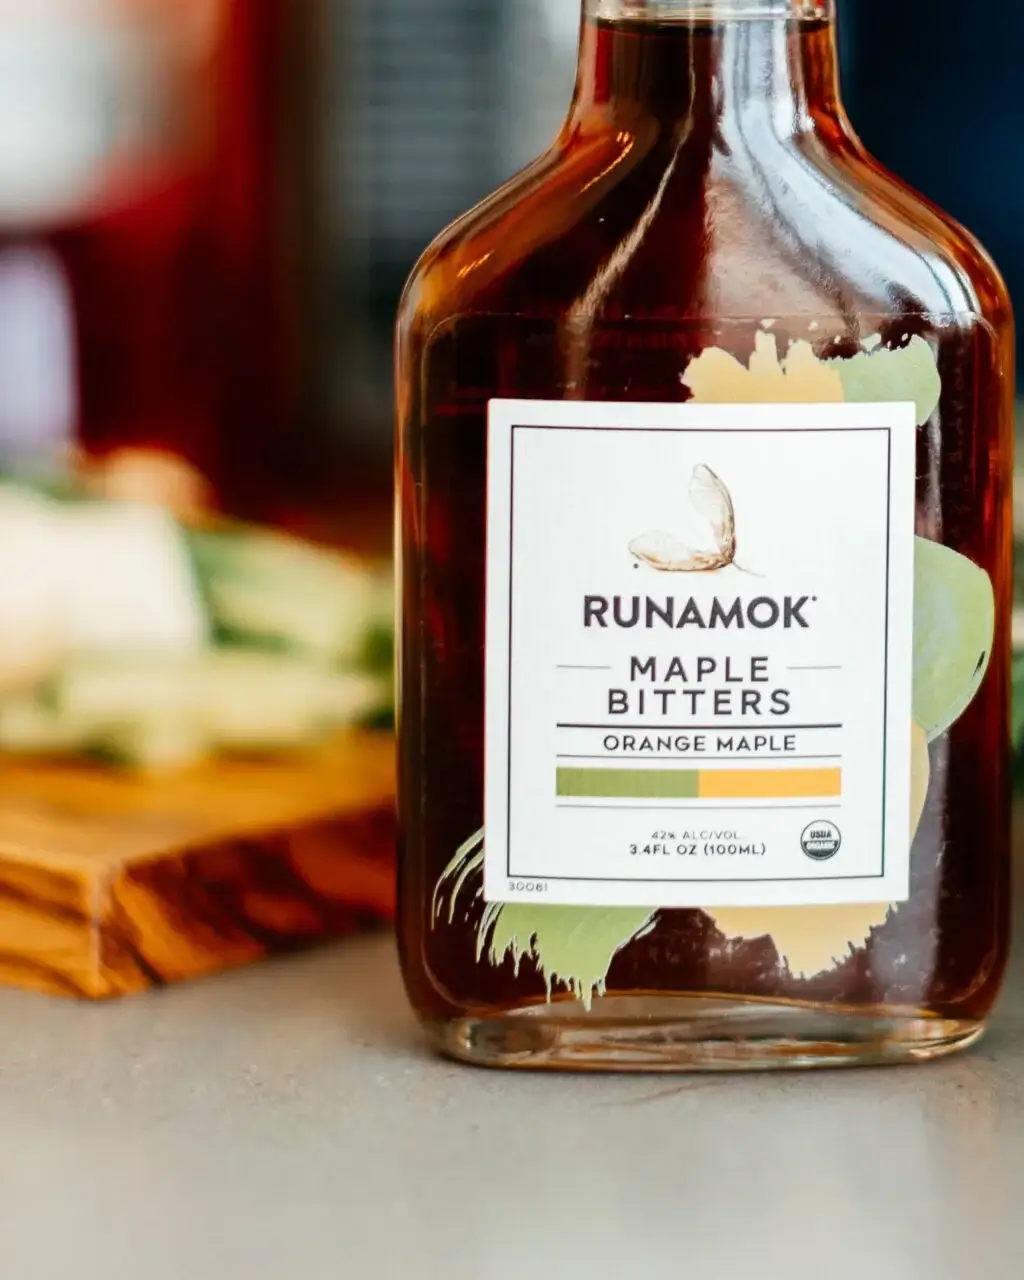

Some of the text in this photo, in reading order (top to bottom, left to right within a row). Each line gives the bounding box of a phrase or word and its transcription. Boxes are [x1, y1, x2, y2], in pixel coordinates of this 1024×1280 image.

[630, 656, 769, 683] MAPLE
[608, 688, 790, 716] BITTERS
[603, 733, 796, 752] ORANGE MAPLE
[809, 829, 832, 839] USDA
[629, 842, 767, 857] 3.4FL OZ (100ML)
